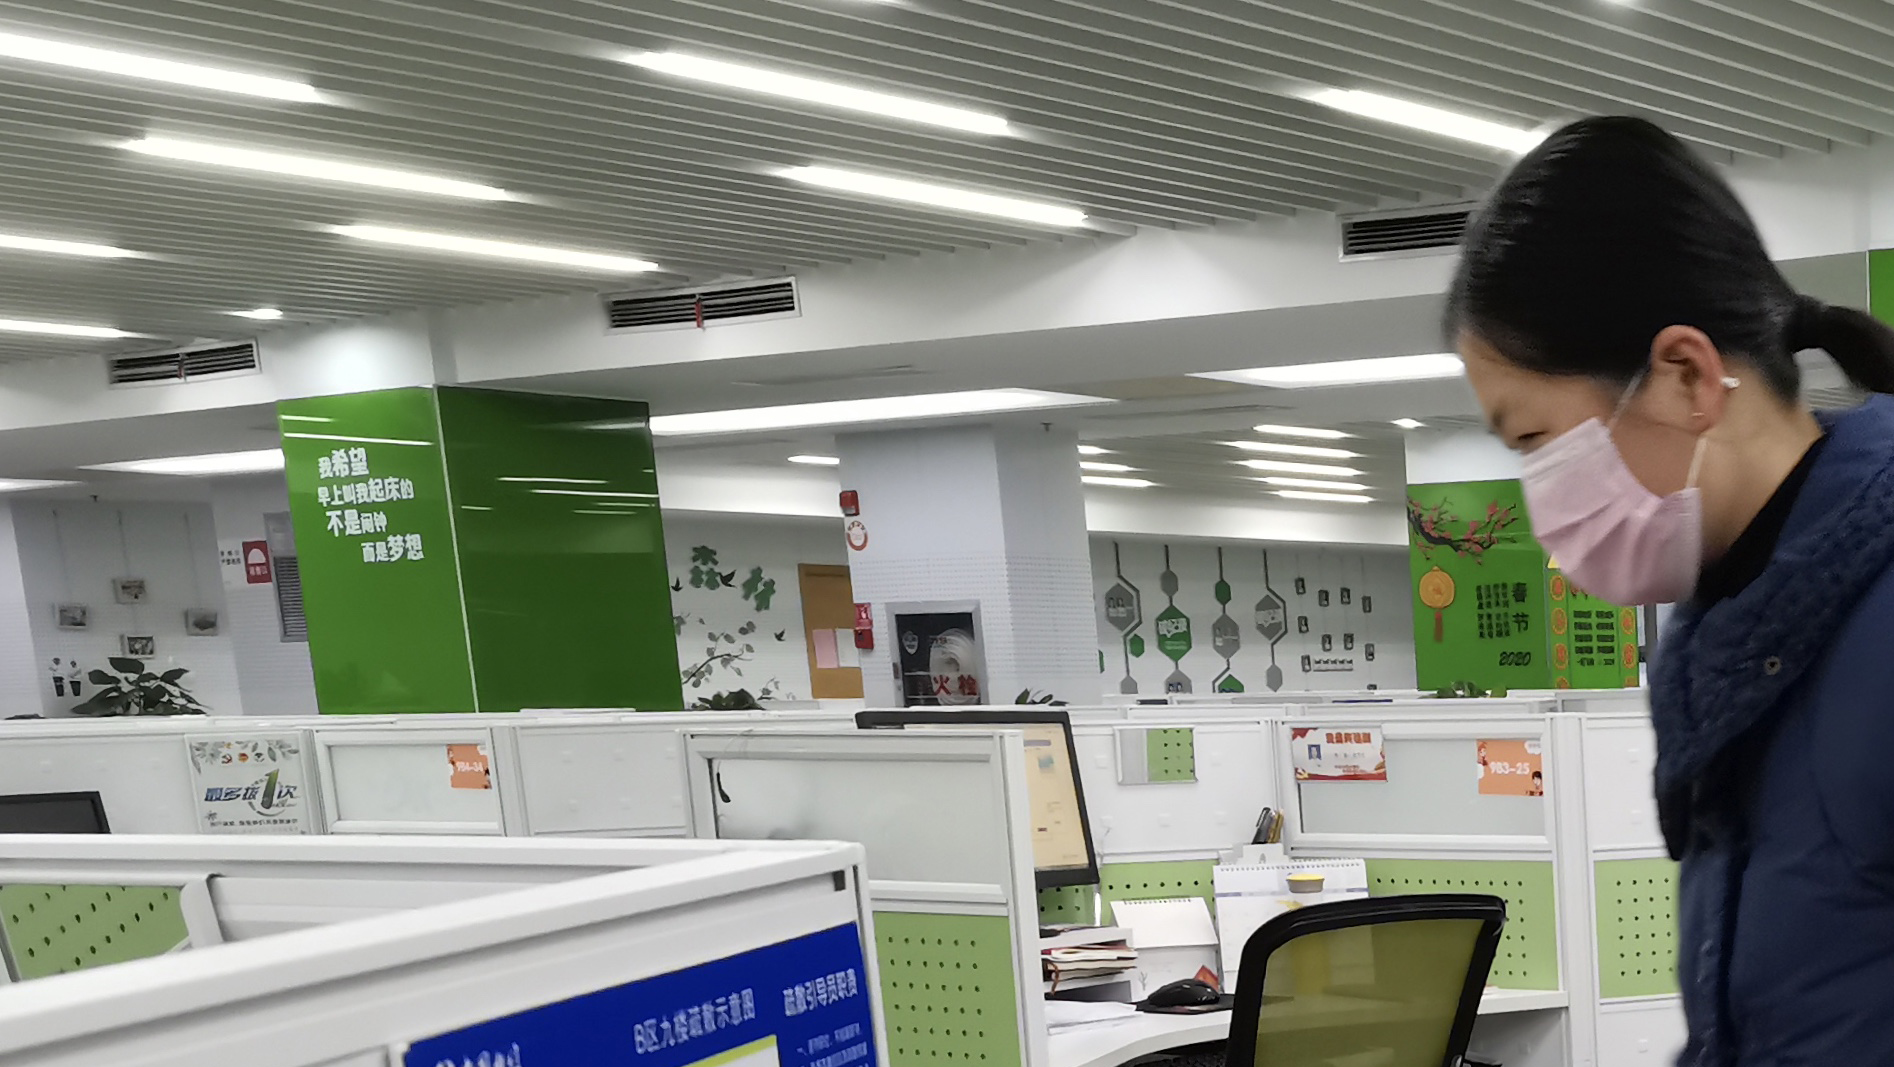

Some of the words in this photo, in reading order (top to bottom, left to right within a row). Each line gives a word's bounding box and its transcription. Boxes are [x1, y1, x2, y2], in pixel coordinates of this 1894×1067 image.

[317, 446, 370, 479] 我希望
[317, 476, 415, 508] 早上叫我起床的
[325, 508, 388, 538] 不是闹钟
[360, 533, 425, 563] 而是梦想
[1511, 581, 1530, 634] 春节
